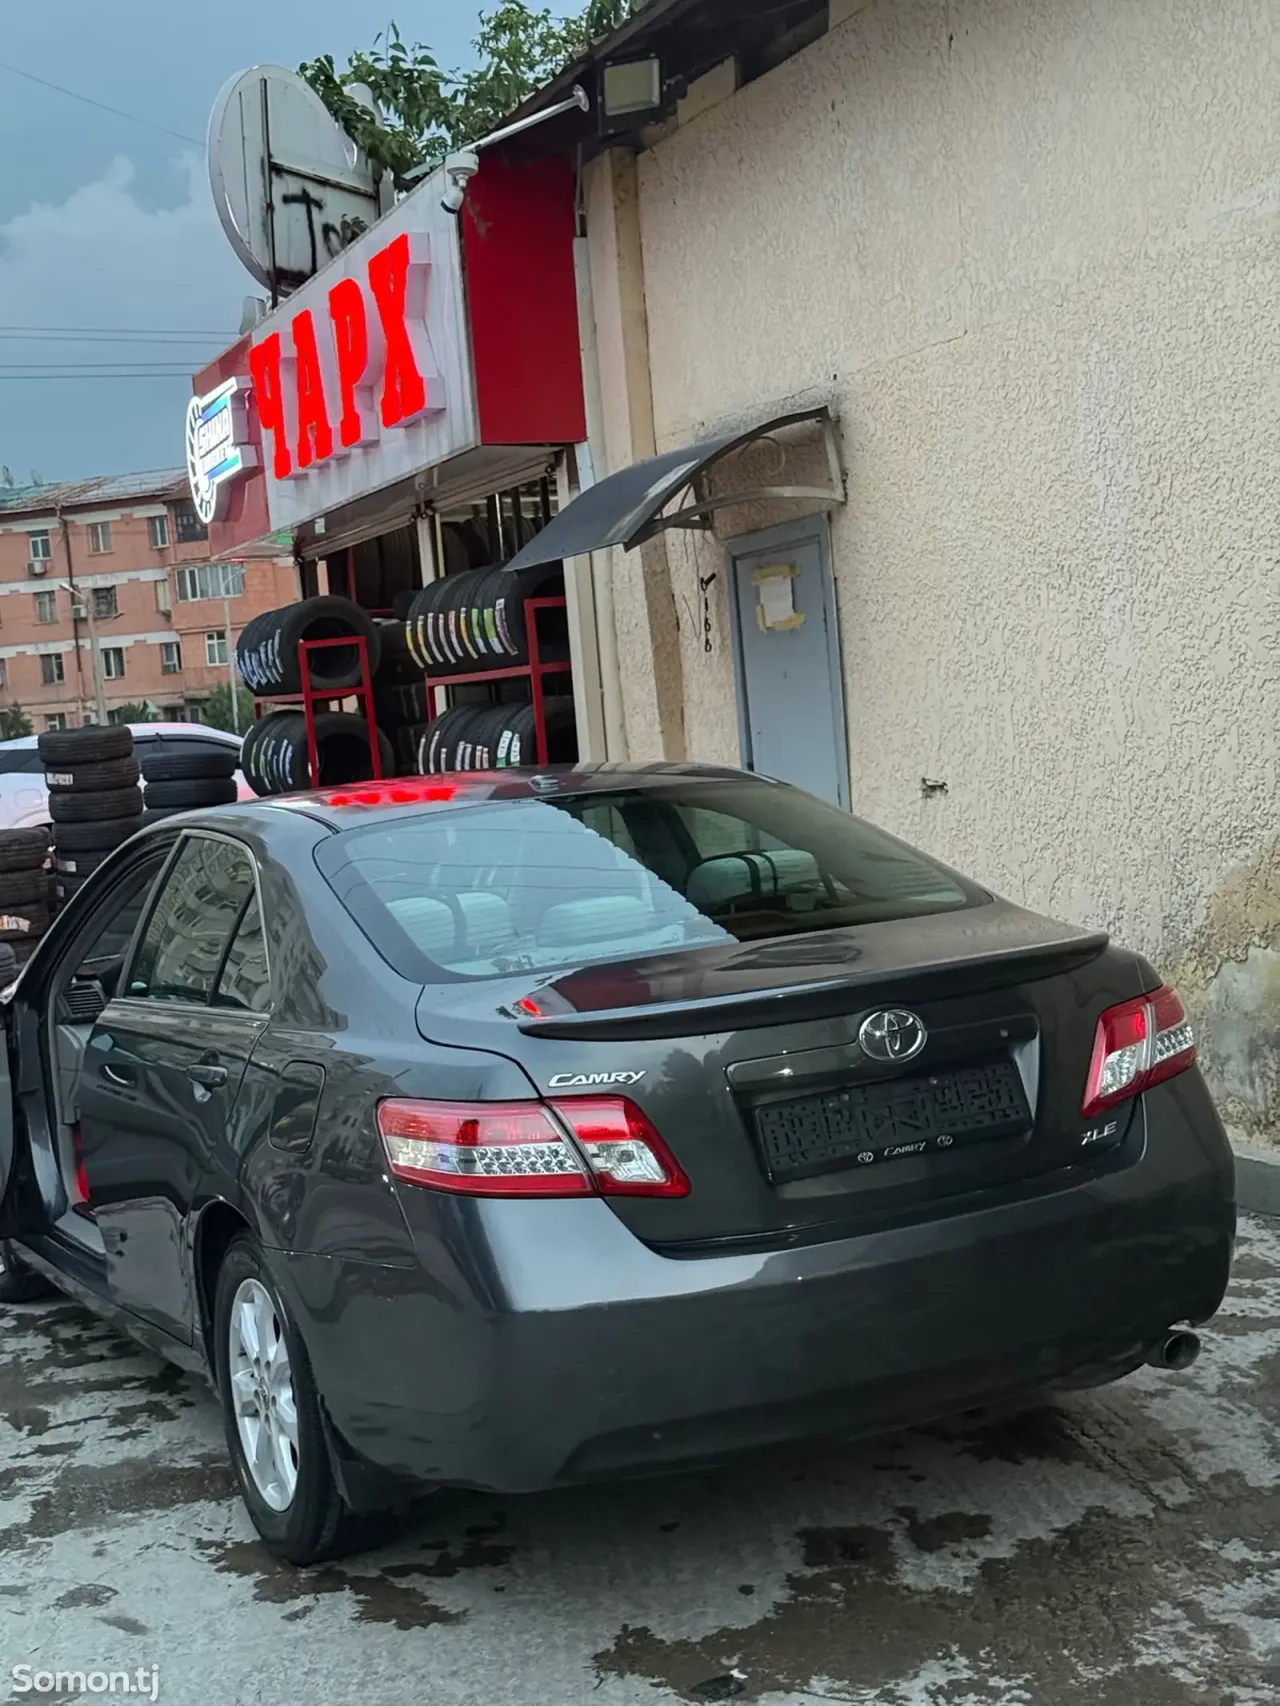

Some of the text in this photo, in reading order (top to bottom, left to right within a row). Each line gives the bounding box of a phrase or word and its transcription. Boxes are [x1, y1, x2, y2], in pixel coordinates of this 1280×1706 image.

[250, 233, 425, 480] ЧАРХ
[548, 1070, 647, 1087] CAMRY
[1080, 1120, 1117, 1145] XLE
[883, 1141, 927, 1157] CAMRY
